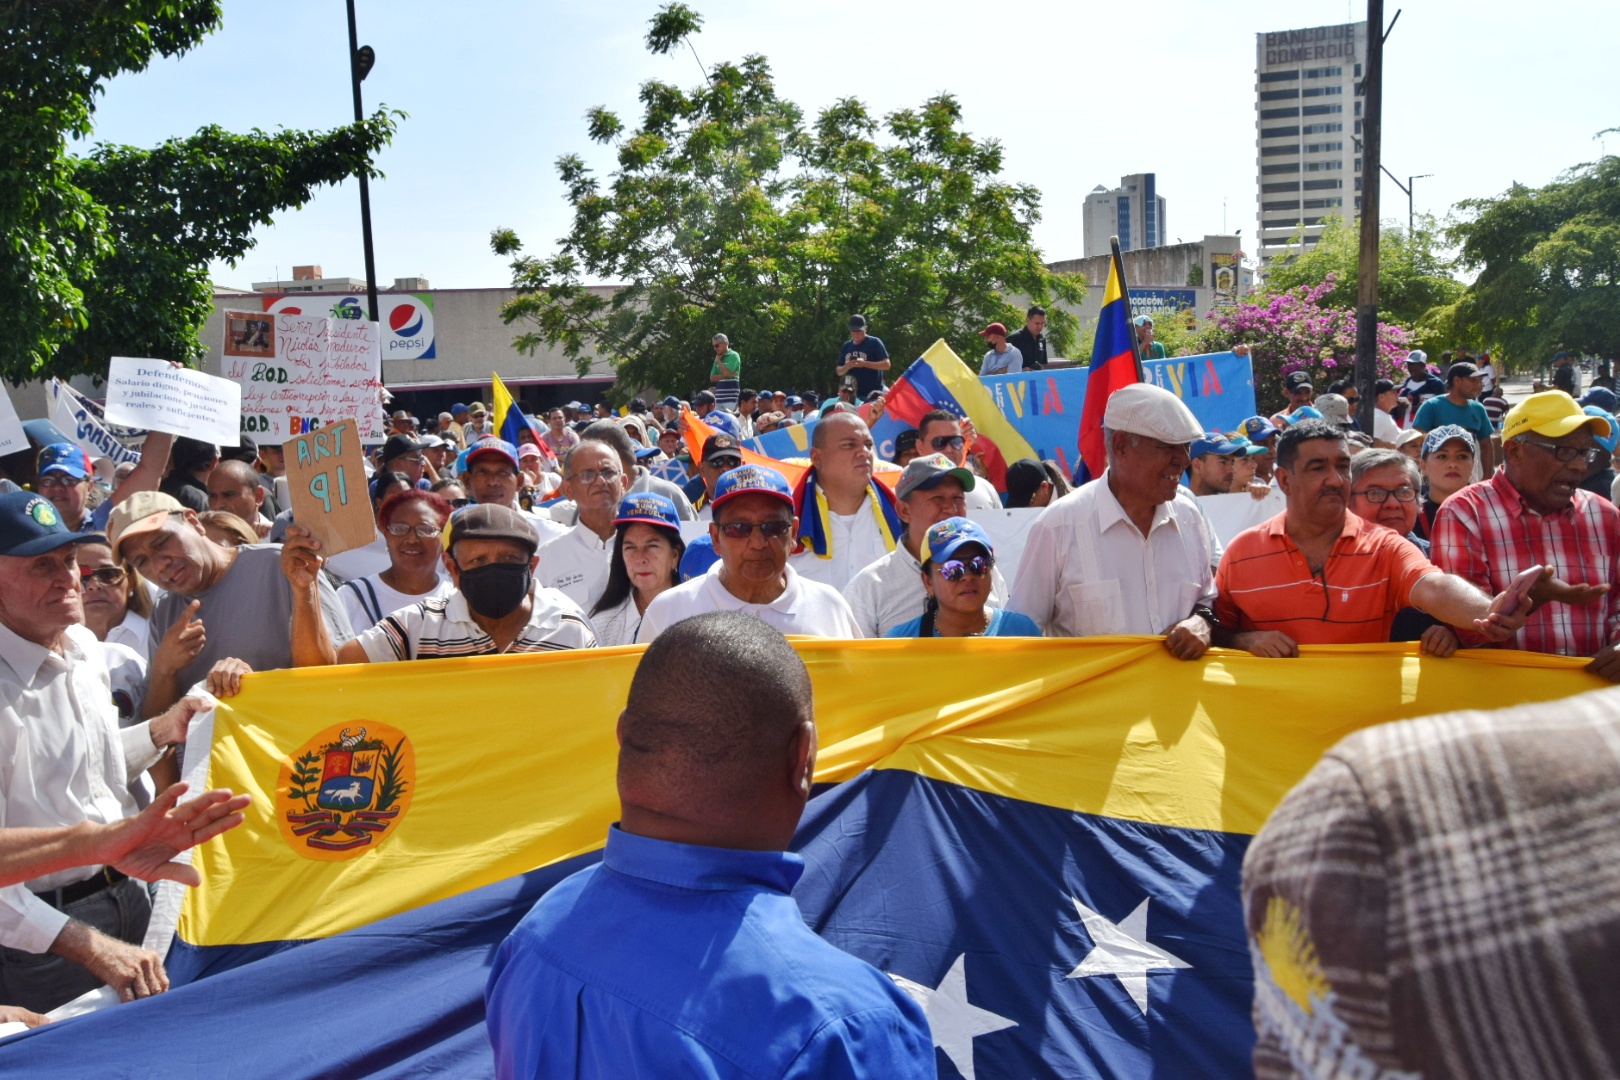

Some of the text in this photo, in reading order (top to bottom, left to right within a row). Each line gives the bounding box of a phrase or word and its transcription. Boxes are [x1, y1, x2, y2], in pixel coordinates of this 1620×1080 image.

[1265, 24, 1355, 46] BANCO DE
[1266, 42, 1355, 65] COMERCIO
[277, 315, 316, 333] Señor
[389, 337, 425, 351] pepsi
[137, 368, 209, 391] Defendemos:
[251, 363, 288, 383] B.O.D.
[115, 378, 228, 405] Salario digno, pensiones
[130, 390, 188, 406] jubilaciones
[126, 401, 156, 409] reales
[166, 406, 216, 423] suficientes
[290, 416, 320, 435] BNC
[297, 424, 346, 470] ART
[309, 465, 347, 513] 91
[726, 480, 777, 493] VENEZUELA
[627, 508, 666, 518] VENEZUELA
